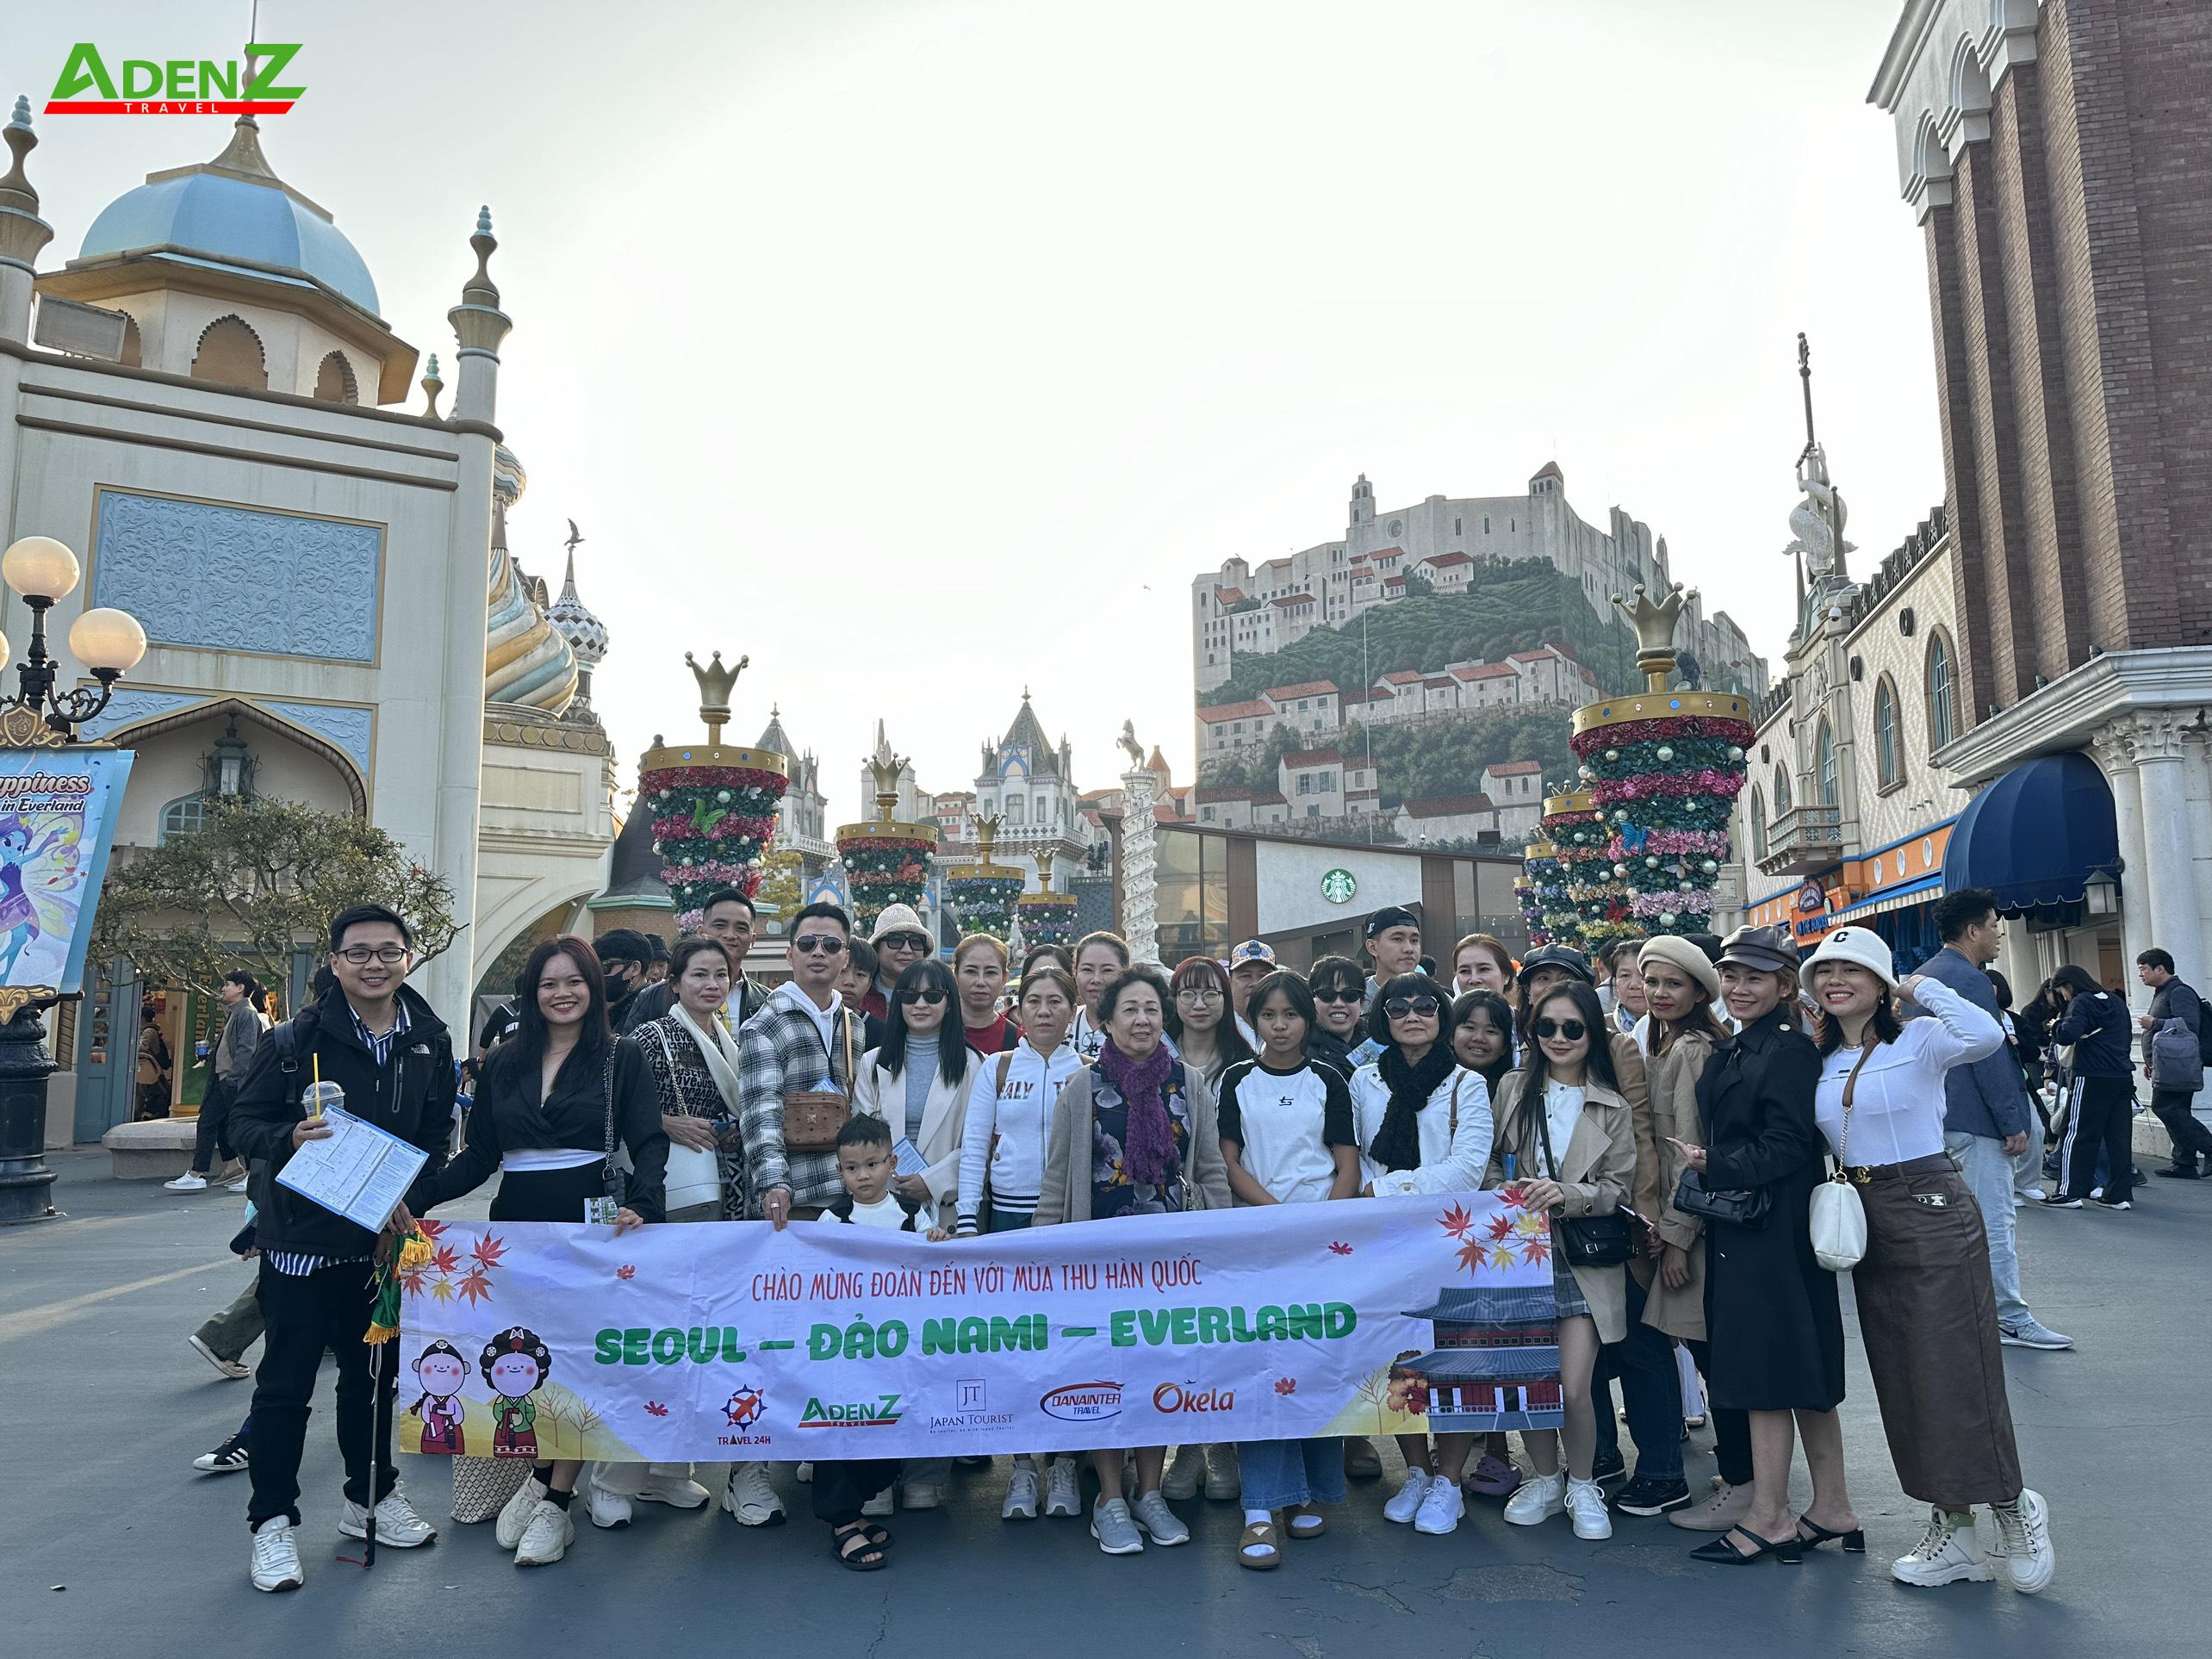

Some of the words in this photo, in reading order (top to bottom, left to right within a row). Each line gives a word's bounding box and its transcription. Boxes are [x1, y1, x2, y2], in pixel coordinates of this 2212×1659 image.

[2, 800, 15, 811] in
[17, 798, 84, 811] Everland
[1833, 931, 1849, 942] C
[752, 1267, 802, 1302] CHÀO
[810, 1267, 864, 1301] MỪNG
[871, 1264, 922, 1297] ĐOÀN
[929, 1261, 966, 1296] ĐẾN
[973, 1261, 1003, 1294] VỚI
[1013, 1261, 1053, 1292] MÙA
[1061, 1264, 1097, 1291] THU
[1105, 1258, 1144, 1289] HÀN
[1152, 1252, 1202, 1293] QUỐC
[594, 1327, 747, 1365] SEOUL
[806, 1313, 909, 1361] ĐẢO
[922, 1314, 1048, 1355] NAMI
[1110, 1302, 1358, 1347] EVERLAND
[963, 1385, 980, 1406] JT
[1052, 1394, 1121, 1407] DANAINTER
[1153, 1382, 1233, 1414] Okela
[1072, 1406, 1102, 1415] TRAVEL
[930, 1416, 964, 1429] JAPAN
[967, 1414, 1014, 1424] TOURIST
[718, 1434, 752, 1445] TRAVEL
[754, 1435, 771, 1445] 24H
